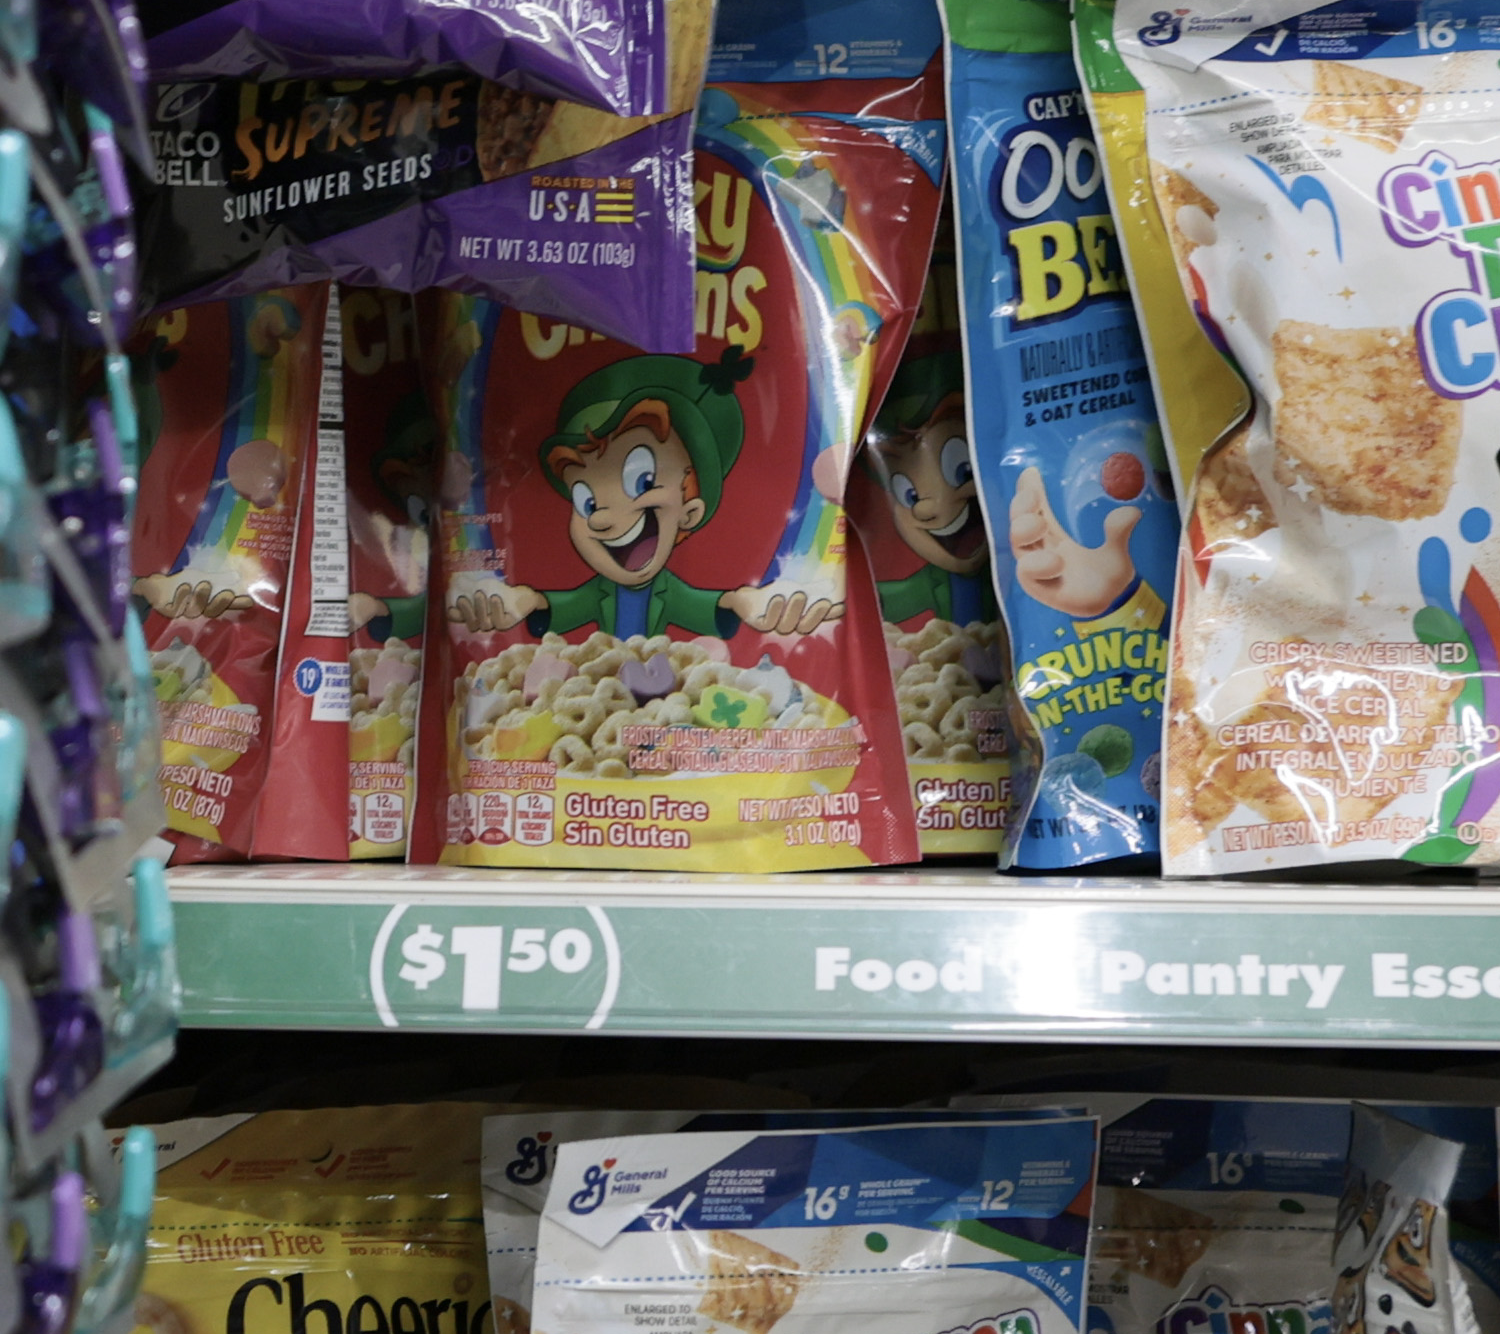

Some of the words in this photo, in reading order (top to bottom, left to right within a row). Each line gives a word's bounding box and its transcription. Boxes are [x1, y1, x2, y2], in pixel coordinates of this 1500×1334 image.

[151, 129, 221, 159] TACO
[153, 159, 222, 188] BELL
[222, 162, 357, 224] SUNFLOWER
[362, 153, 433, 193] SEEDS
[459, 235, 491, 261] NET
[496, 235, 523, 261] WT
[527, 237, 562, 263] 3.63
[566, 240, 588, 264] OZ
[592, 240, 636, 268] (103g)
[565, 793, 646, 821] Gluten
[650, 795, 709, 822] Free
[814, 942, 987, 996] Food
[1097, 945, 1341, 1014] Pantry
[612, 1182, 643, 1197] Mills
[613, 1167, 669, 1185] General
